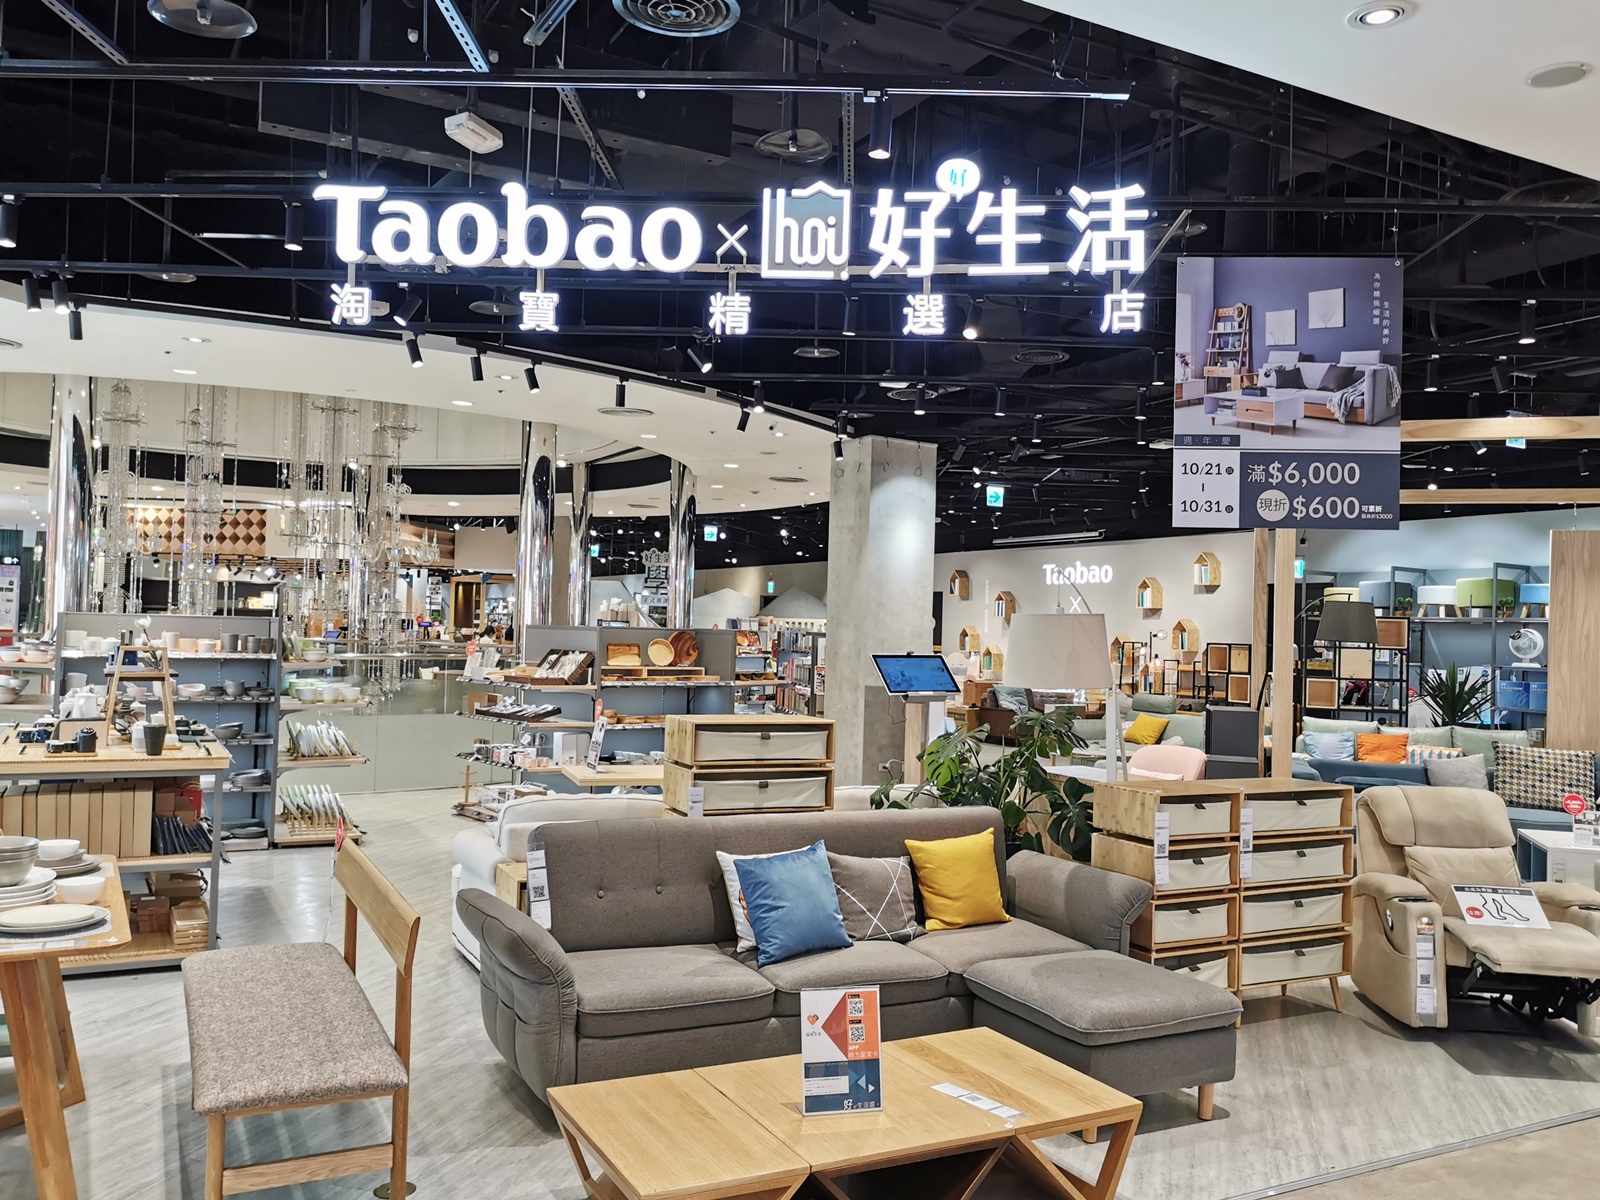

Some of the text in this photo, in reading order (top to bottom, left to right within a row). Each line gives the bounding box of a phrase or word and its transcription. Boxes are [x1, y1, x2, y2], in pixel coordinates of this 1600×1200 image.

[312, 181, 703, 275] Taobao
[868, 183, 1150, 280] 好生活
[1181, 462, 1223, 475] 10/21
[1180, 500, 1222, 513] 10/31
[1258, 495, 1360, 520] 現折 $600
[1361, 505, 1383, 513] 可累折
[1042, 560, 1114, 585] Taobao
